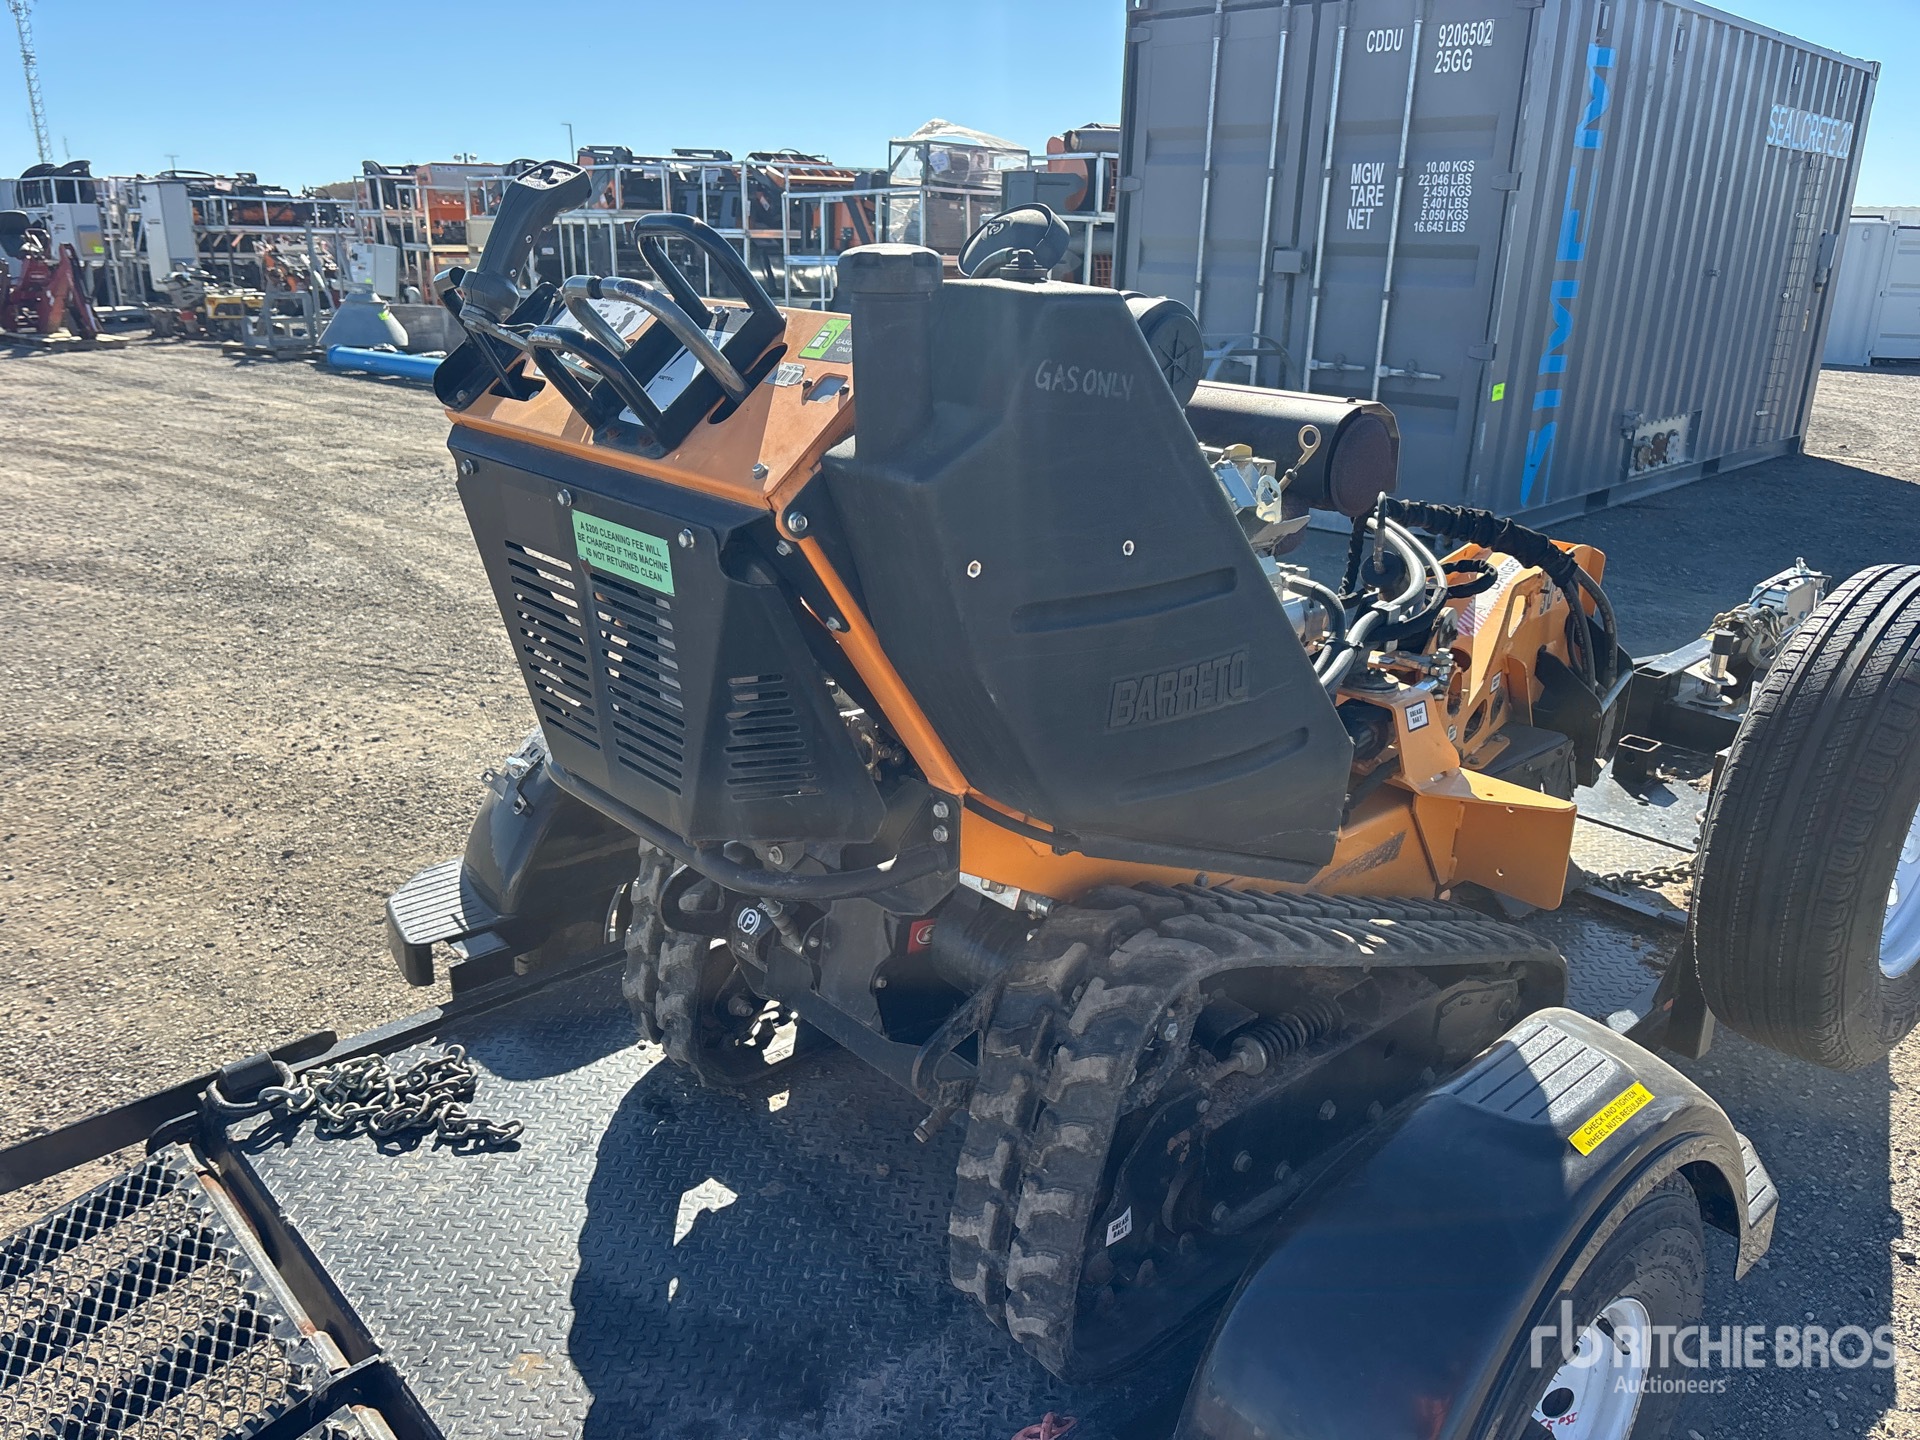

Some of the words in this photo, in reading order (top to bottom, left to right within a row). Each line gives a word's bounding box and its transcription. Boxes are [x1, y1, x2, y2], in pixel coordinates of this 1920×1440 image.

[1366, 29, 1404, 53] CDDU
[1438, 20, 1494, 47] 9206502
[1434, 48, 1473, 73] 25GG
[1766, 105, 1840, 155] SEALCRETE
[1350, 162, 1385, 185] MGW
[1426, 161, 1451, 173] 10.00
[1452, 160, 1475, 173] KGS
[1418, 174, 1449, 186] 22.046
[1451, 173, 1472, 185] LBS
[1423, 186, 1449, 198] 2.450
[1449, 185, 1472, 197] KGS
[1350, 185, 1385, 207] TARE
[1422, 198, 1447, 210] 5.401
[1448, 197, 1469, 209] LBS
[1346, 208, 1374, 230] NET
[1413, 221, 1444, 233] 16.645
[1445, 221, 1466, 233] LBS
[1420, 209, 1446, 221] 5.050
[1446, 209, 1469, 221] KGS
[1035, 359, 1080, 393] GAS
[1083, 368, 1134, 401] ONLY
[580, 521, 586, 530] A
[586, 522, 599, 535] $200
[599, 528, 631, 546] CLEANING
[631, 538, 644, 551] FEE
[645, 543, 662, 557] WILL
[577, 532, 586, 542] BE
[586, 536, 616, 553] CHARGED
[617, 546, 623, 555] IF
[623, 548, 638, 561] THIS
[638, 553, 669, 573] MACHINE
[585, 547, 592, 557] IS
[592, 549, 606, 560] NOT
[606, 554, 640, 574] RETURNED
[640, 567, 663, 583] CLEAN
[1491, 558, 1520, 591] DANGE
[1108, 650, 1250, 728] BARRETO
[1583, 1115, 1605, 1136] CHECK
[1604, 1106, 1617, 1119] AND
[1614, 1089, 1637, 1109] TIGHTEN
[1585, 1128, 1609, 1148] WHEEL
[1605, 1115, 1622, 1131] NUTS
[1620, 1094, 1648, 1117] REGULARLY
[1558, 1411, 1577, 1425] PSI
